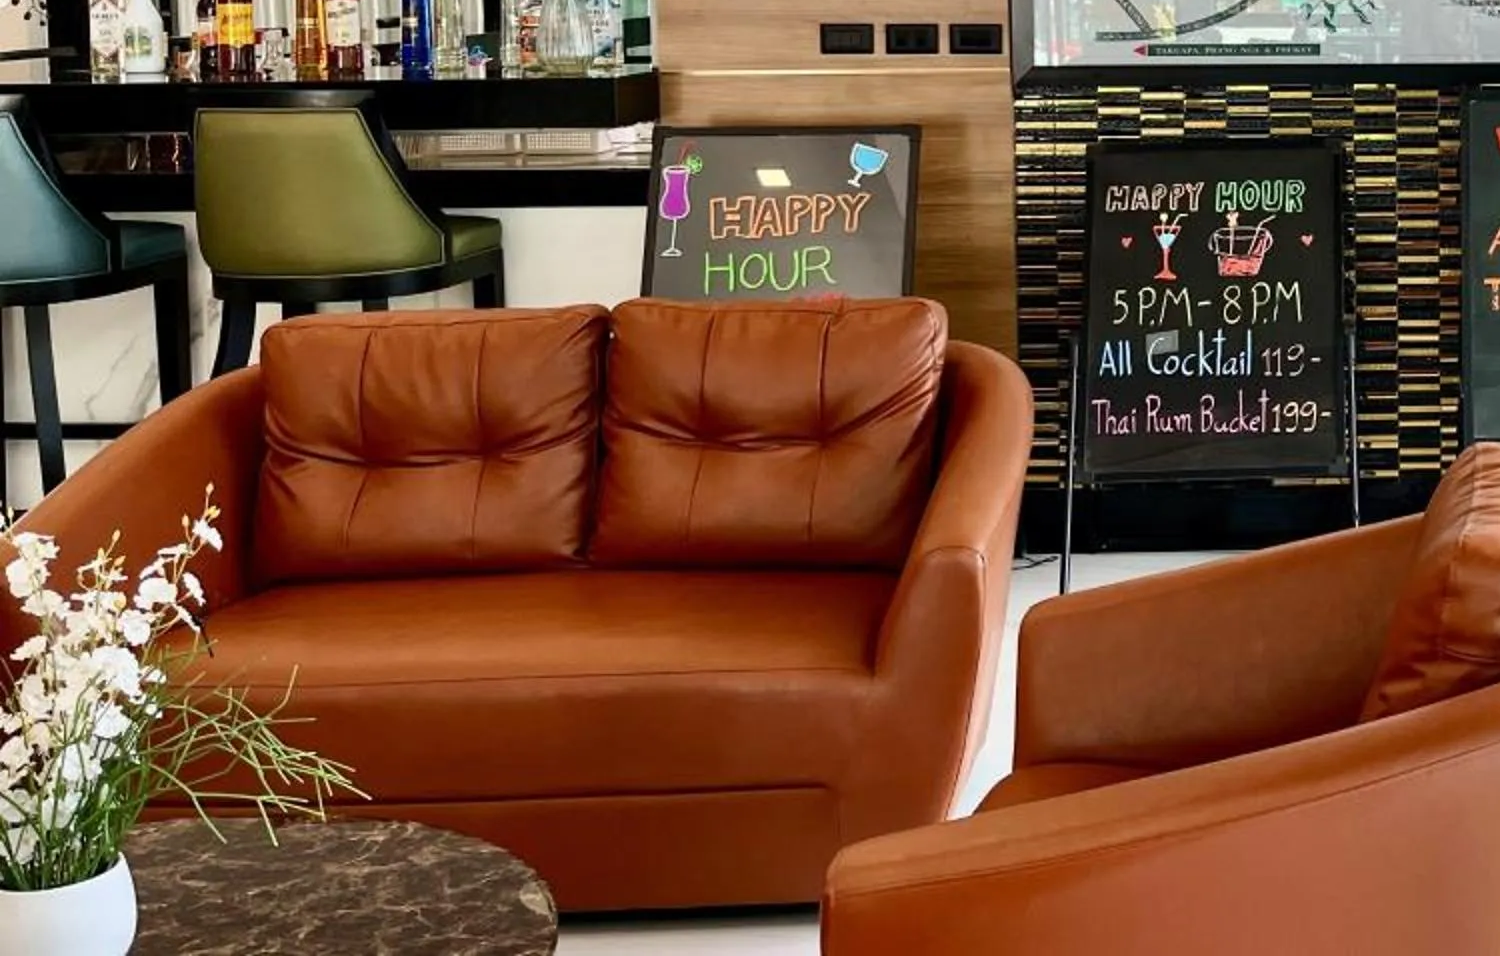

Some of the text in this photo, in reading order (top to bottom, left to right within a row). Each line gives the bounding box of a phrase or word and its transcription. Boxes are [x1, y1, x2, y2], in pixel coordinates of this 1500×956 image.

[709, 191, 871, 240] HAPPY
[1105, 179, 1306, 213] HAPPY HOUR
[704, 245, 838, 296] HOUR
[1099, 340, 1133, 377] All
[1148, 327, 1252, 378] Cocktail
[1091, 399, 1138, 436] Thai
[1145, 394, 1193, 435] Rum
[1200, 389, 1271, 434] Bucket
